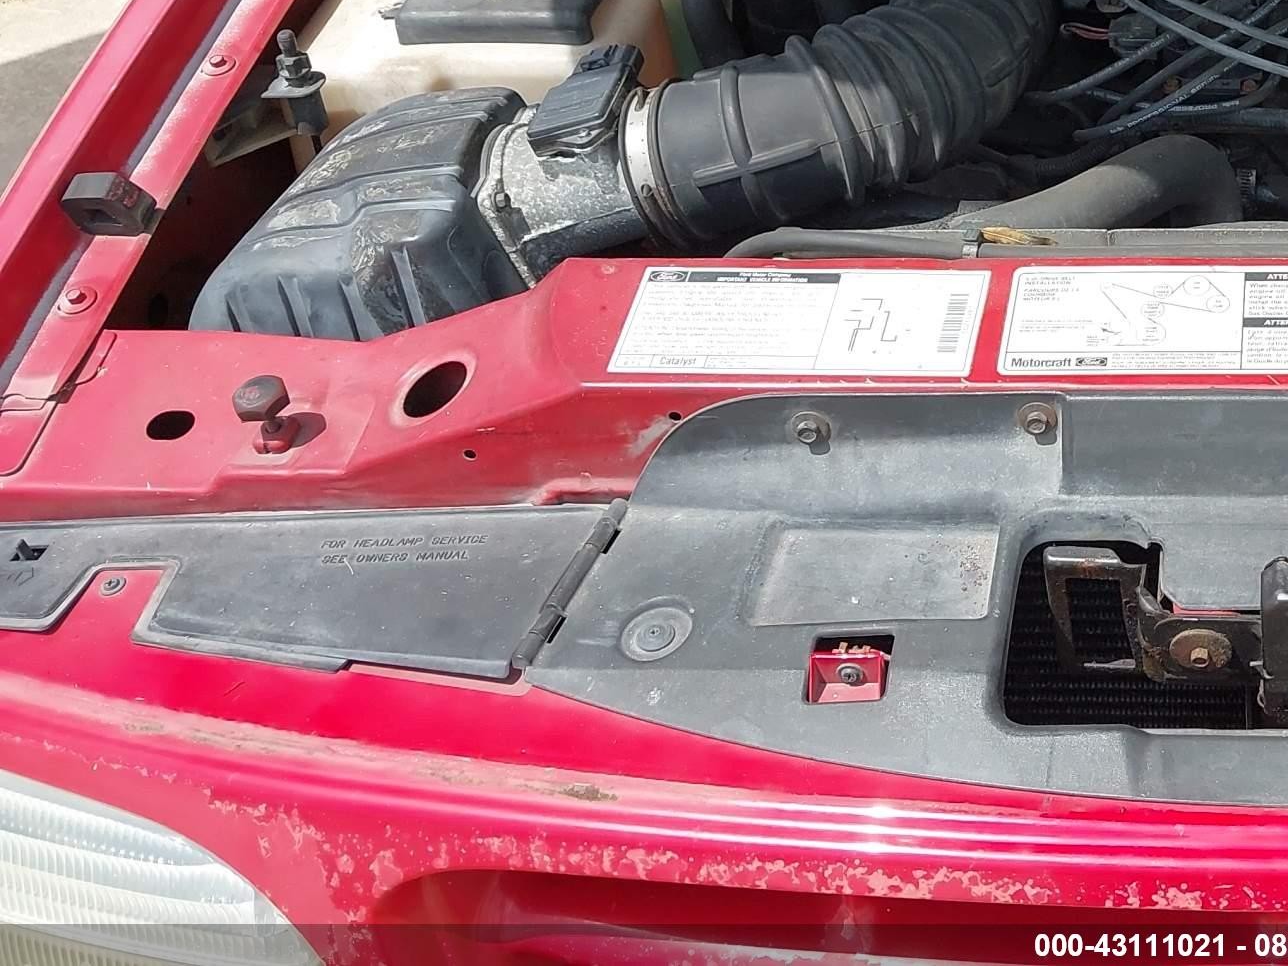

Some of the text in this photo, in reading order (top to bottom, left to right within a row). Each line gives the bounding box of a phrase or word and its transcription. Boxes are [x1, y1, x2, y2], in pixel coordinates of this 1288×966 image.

[659, 356, 697, 366] Catalyst
[1010, 357, 1071, 367] Motorcraft
[321, 535, 488, 549] FOR HEADLAMP SERVICE
[321, 551, 468, 564] SEE OWNERS MANUAL
